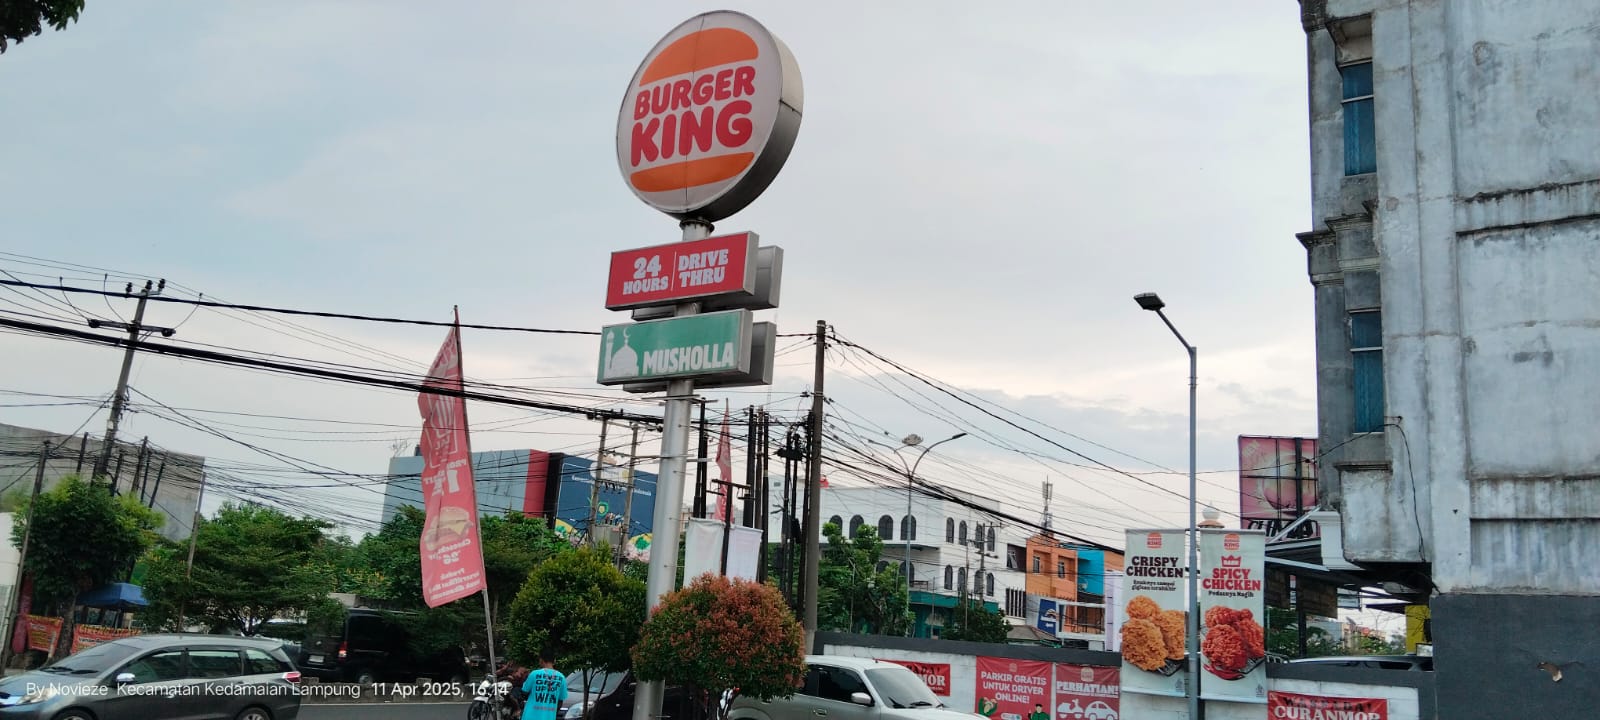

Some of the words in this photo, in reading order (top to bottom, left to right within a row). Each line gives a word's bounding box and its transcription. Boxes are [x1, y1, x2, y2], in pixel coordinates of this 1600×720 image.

[634, 66, 756, 121] BURGER
[631, 100, 753, 167] KING
[633, 255, 662, 279] 24
[678, 249, 729, 272] DRIVE
[679, 266, 726, 288] THRU
[622, 276, 669, 295] HOURS
[642, 342, 734, 376] MUSHOLLA
[1131, 556, 1179, 567] CRISPY
[1126, 566, 1184, 578] CHICKEN
[1212, 568, 1251, 579] SPICY
[1202, 578, 1261, 591] CHICKEN
[981, 671, 1013, 682] PARKIR
[1014, 674, 1047, 686] GRATIS
[983, 681, 1010, 692] UNTUK
[1011, 684, 1044, 695] DRIVER
[1056, 681, 1119, 695] PERHATIAN!
[535, 692, 557, 704] WIN
[995, 692, 1030, 704] ONLINE!
[1273, 705, 1381, 720] CURANMOR
